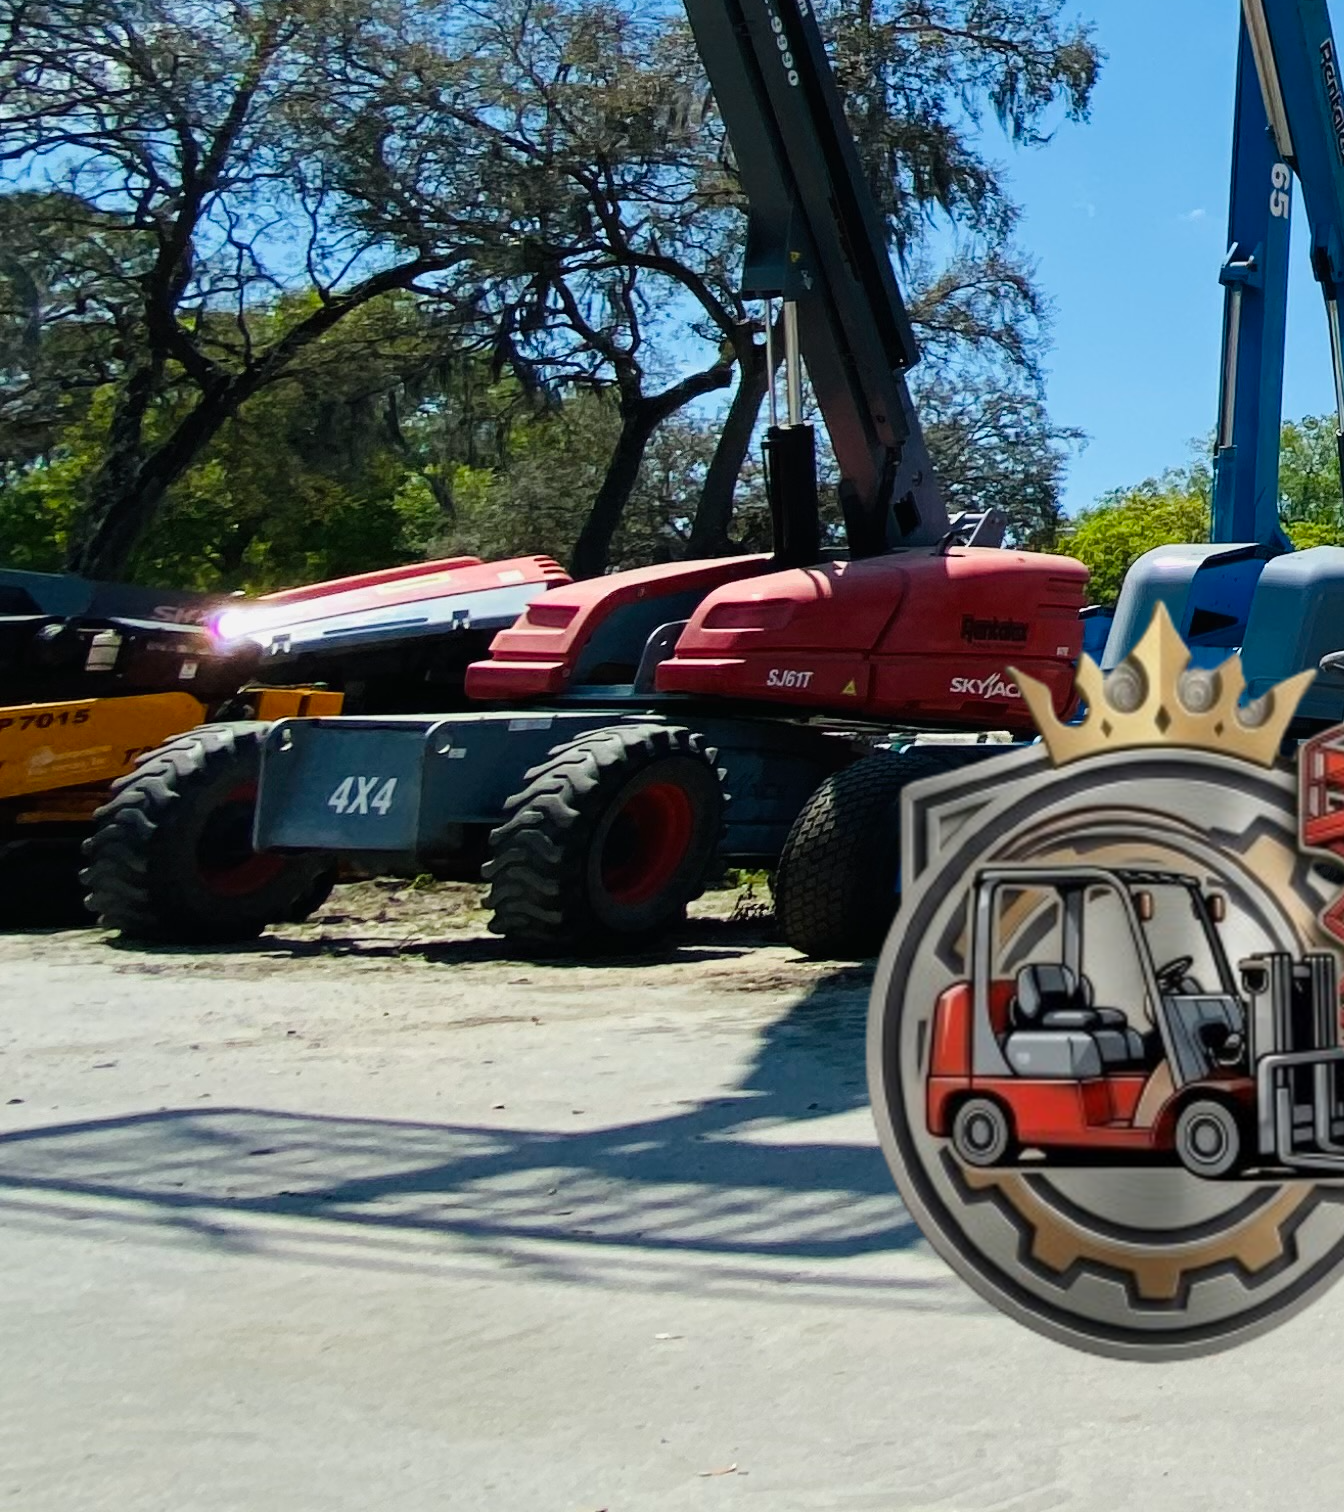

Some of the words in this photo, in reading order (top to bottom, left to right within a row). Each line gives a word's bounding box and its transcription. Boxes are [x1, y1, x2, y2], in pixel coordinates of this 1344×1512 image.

[1270, 162, 1290, 220] 65
[949, 672, 1022, 699] SKYJAC
[327, 776, 398, 815] 4X4
